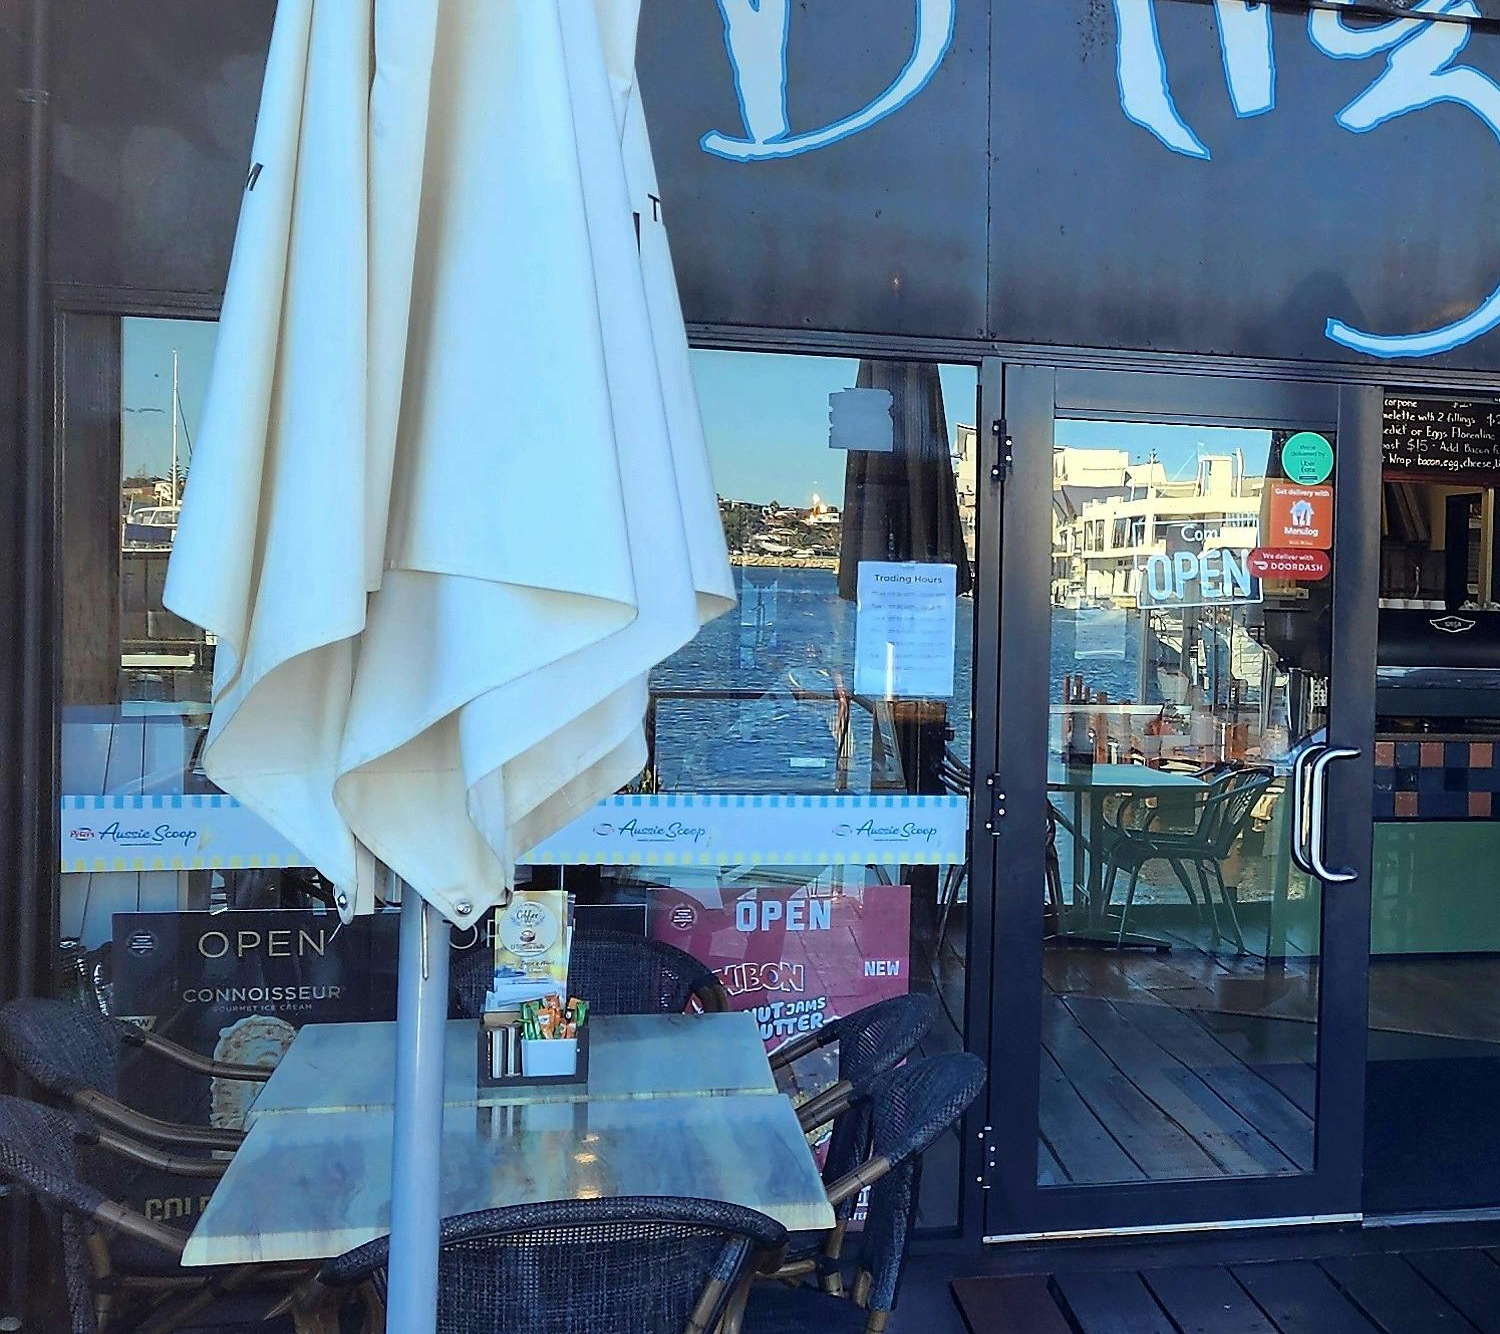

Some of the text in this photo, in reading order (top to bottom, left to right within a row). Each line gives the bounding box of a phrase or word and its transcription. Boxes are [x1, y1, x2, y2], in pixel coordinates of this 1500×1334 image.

[1418, 411, 1434, 421] with
[1437, 411, 1444, 422] 2
[1446, 412, 1475, 427] fillings
[1426, 425, 1448, 440] Eggs
[1406, 438, 1429, 452] $15
[1439, 441, 1459, 453] Add
[1288, 488, 1313, 497] delivery
[1147, 549, 1251, 601] OPEN
[1270, 561, 1323, 572] DOORDASH
[874, 574, 943, 584] Trading Hours
[98, 821, 151, 843] Aussie
[151, 824, 198, 847] Scoop
[618, 818, 664, 838] Aussie
[664, 821, 706, 844] Scoop
[856, 819, 900, 838] Aussie
[900, 820, 937, 844] Scoop
[736, 899, 831, 932] OPEN
[198, 929, 326, 959] OPEN
[865, 960, 900, 977] NEW
[183, 986, 341, 1003] CONNOISSEUR
[213, 1004, 258, 1013] GOURMET
[261, 1004, 277, 1012] ICE
[786, 996, 827, 1016] JAMS
